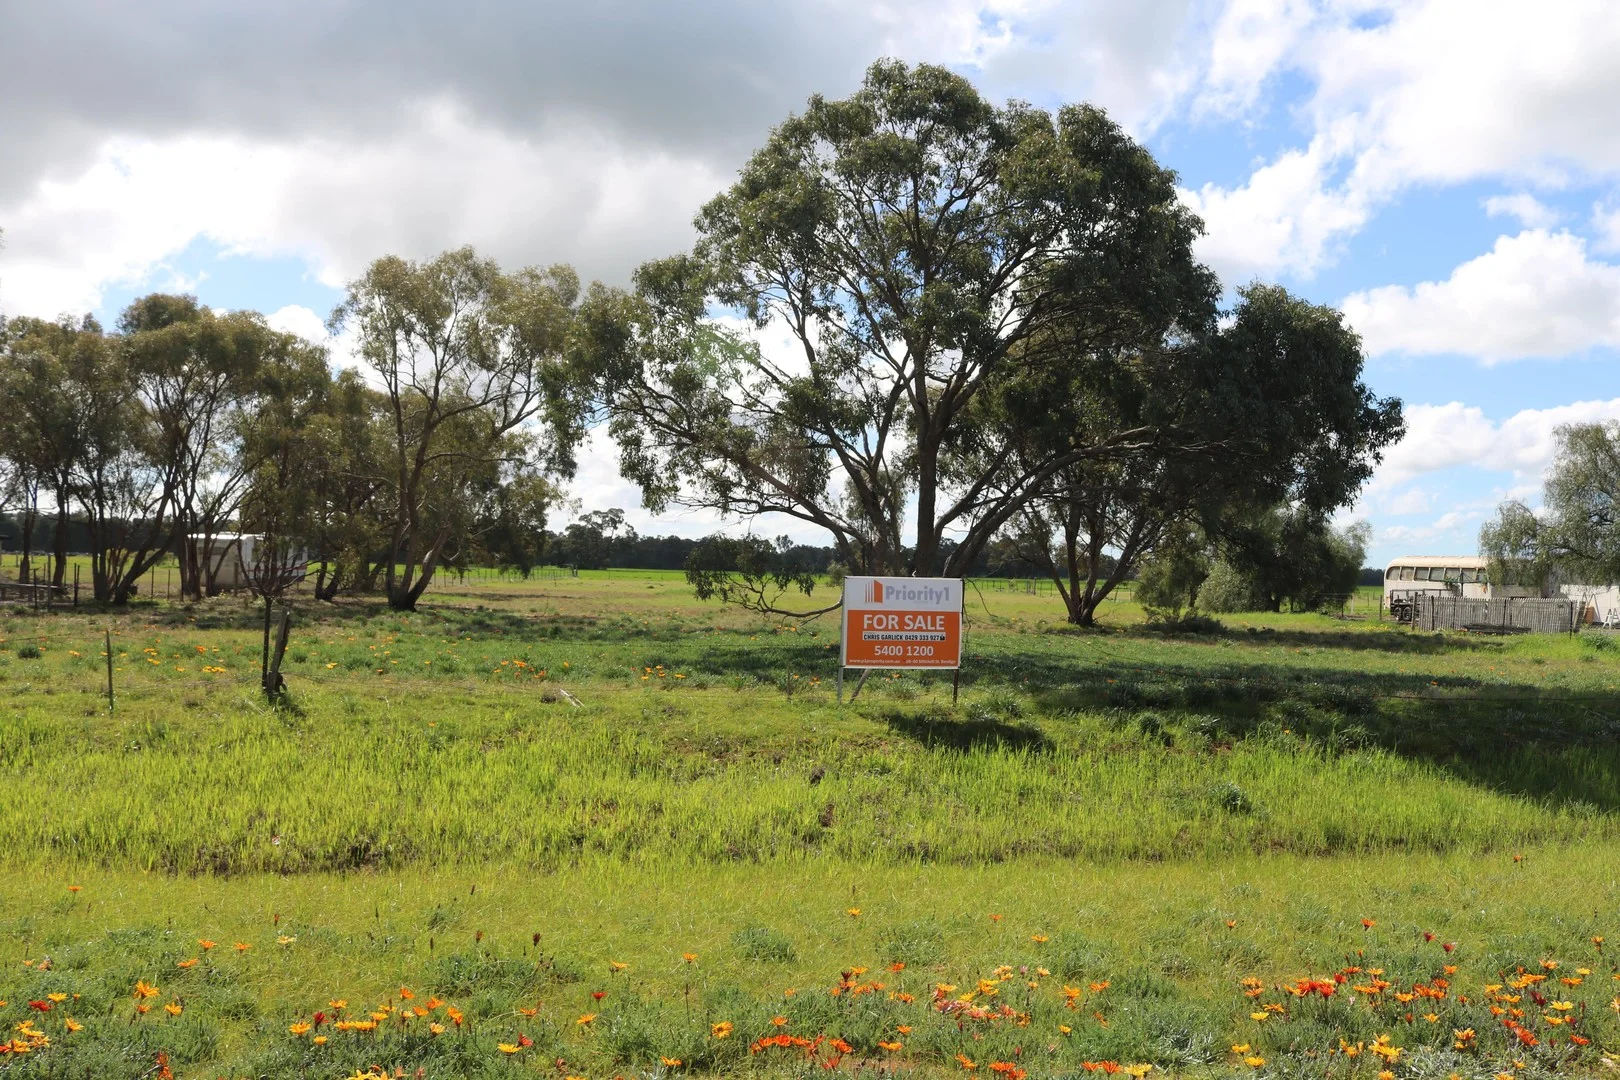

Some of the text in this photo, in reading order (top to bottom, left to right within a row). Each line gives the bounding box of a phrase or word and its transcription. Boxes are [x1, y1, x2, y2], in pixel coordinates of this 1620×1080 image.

[886, 585, 950, 605] Priority1
[863, 614, 945, 630] FOR SALE
[874, 645, 934, 656] 5400 1200
